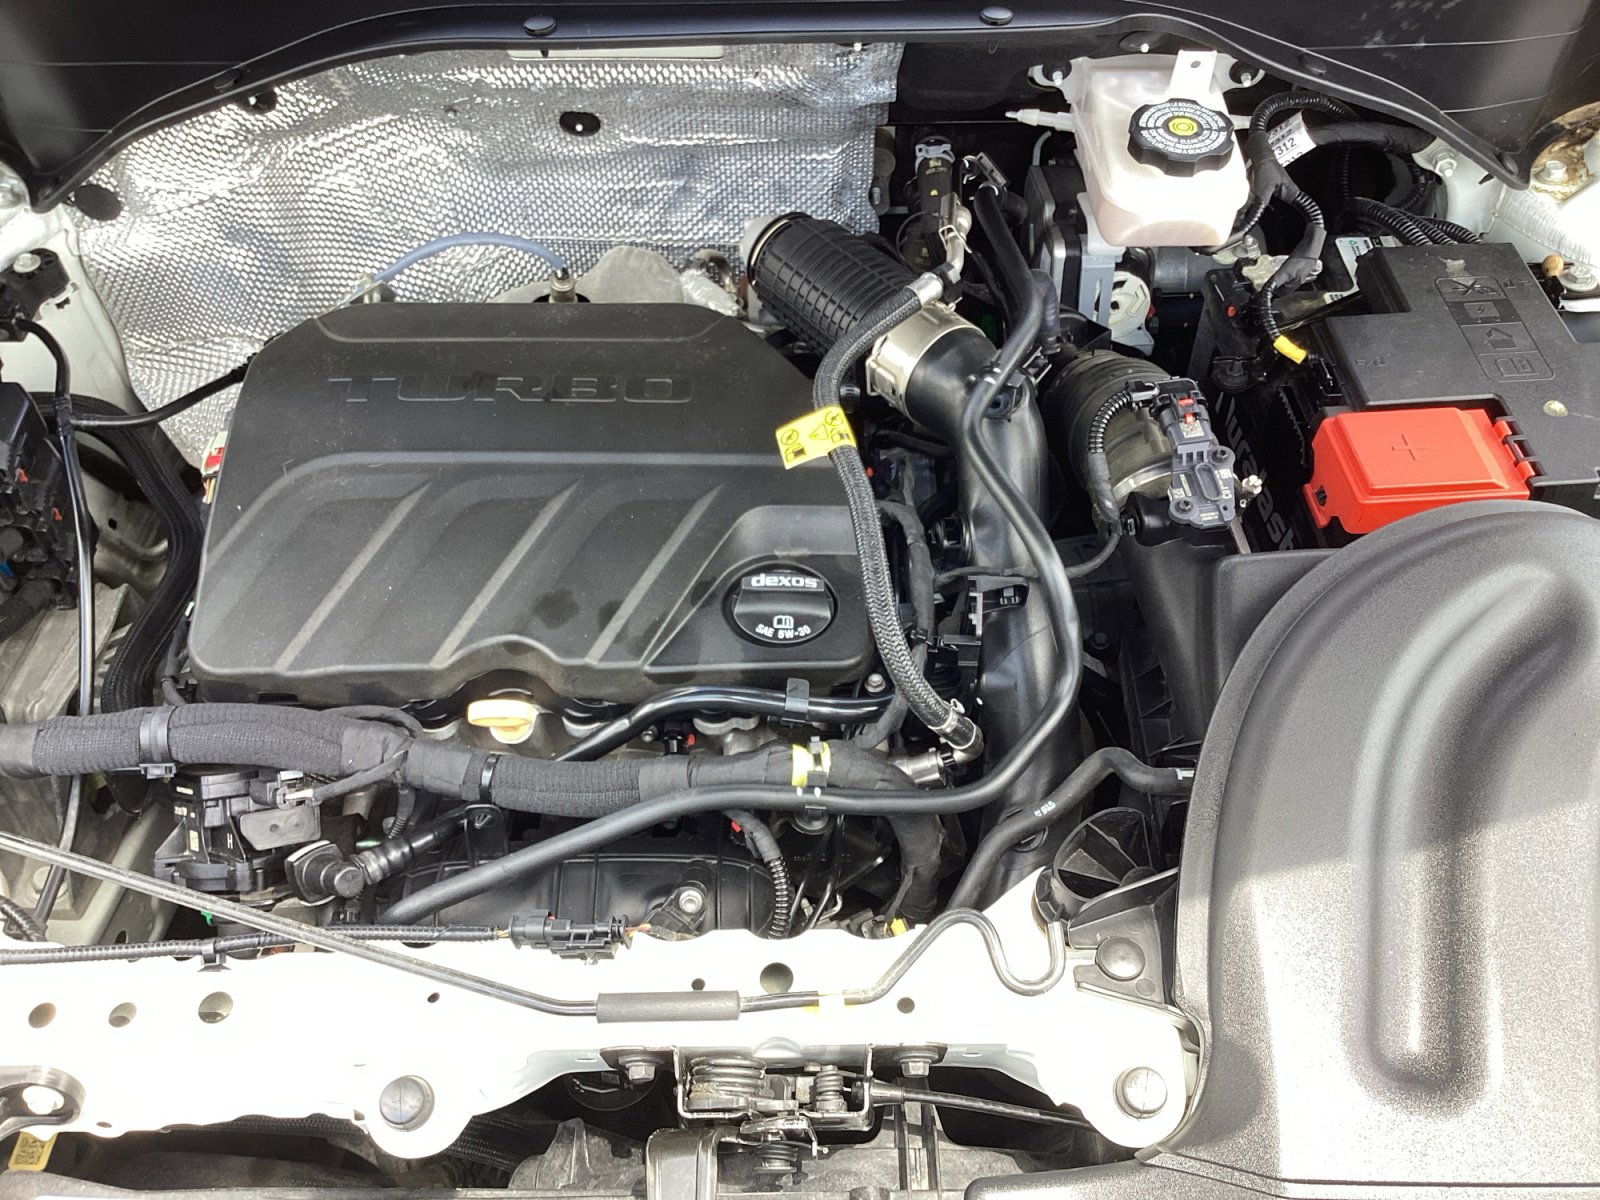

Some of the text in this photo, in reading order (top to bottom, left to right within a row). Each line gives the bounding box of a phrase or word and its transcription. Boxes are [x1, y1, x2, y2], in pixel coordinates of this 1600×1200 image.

[328, 375, 692, 402] TURBO
[751, 573, 820, 588] dexos
[755, 623, 811, 639] SAE 5W-30
